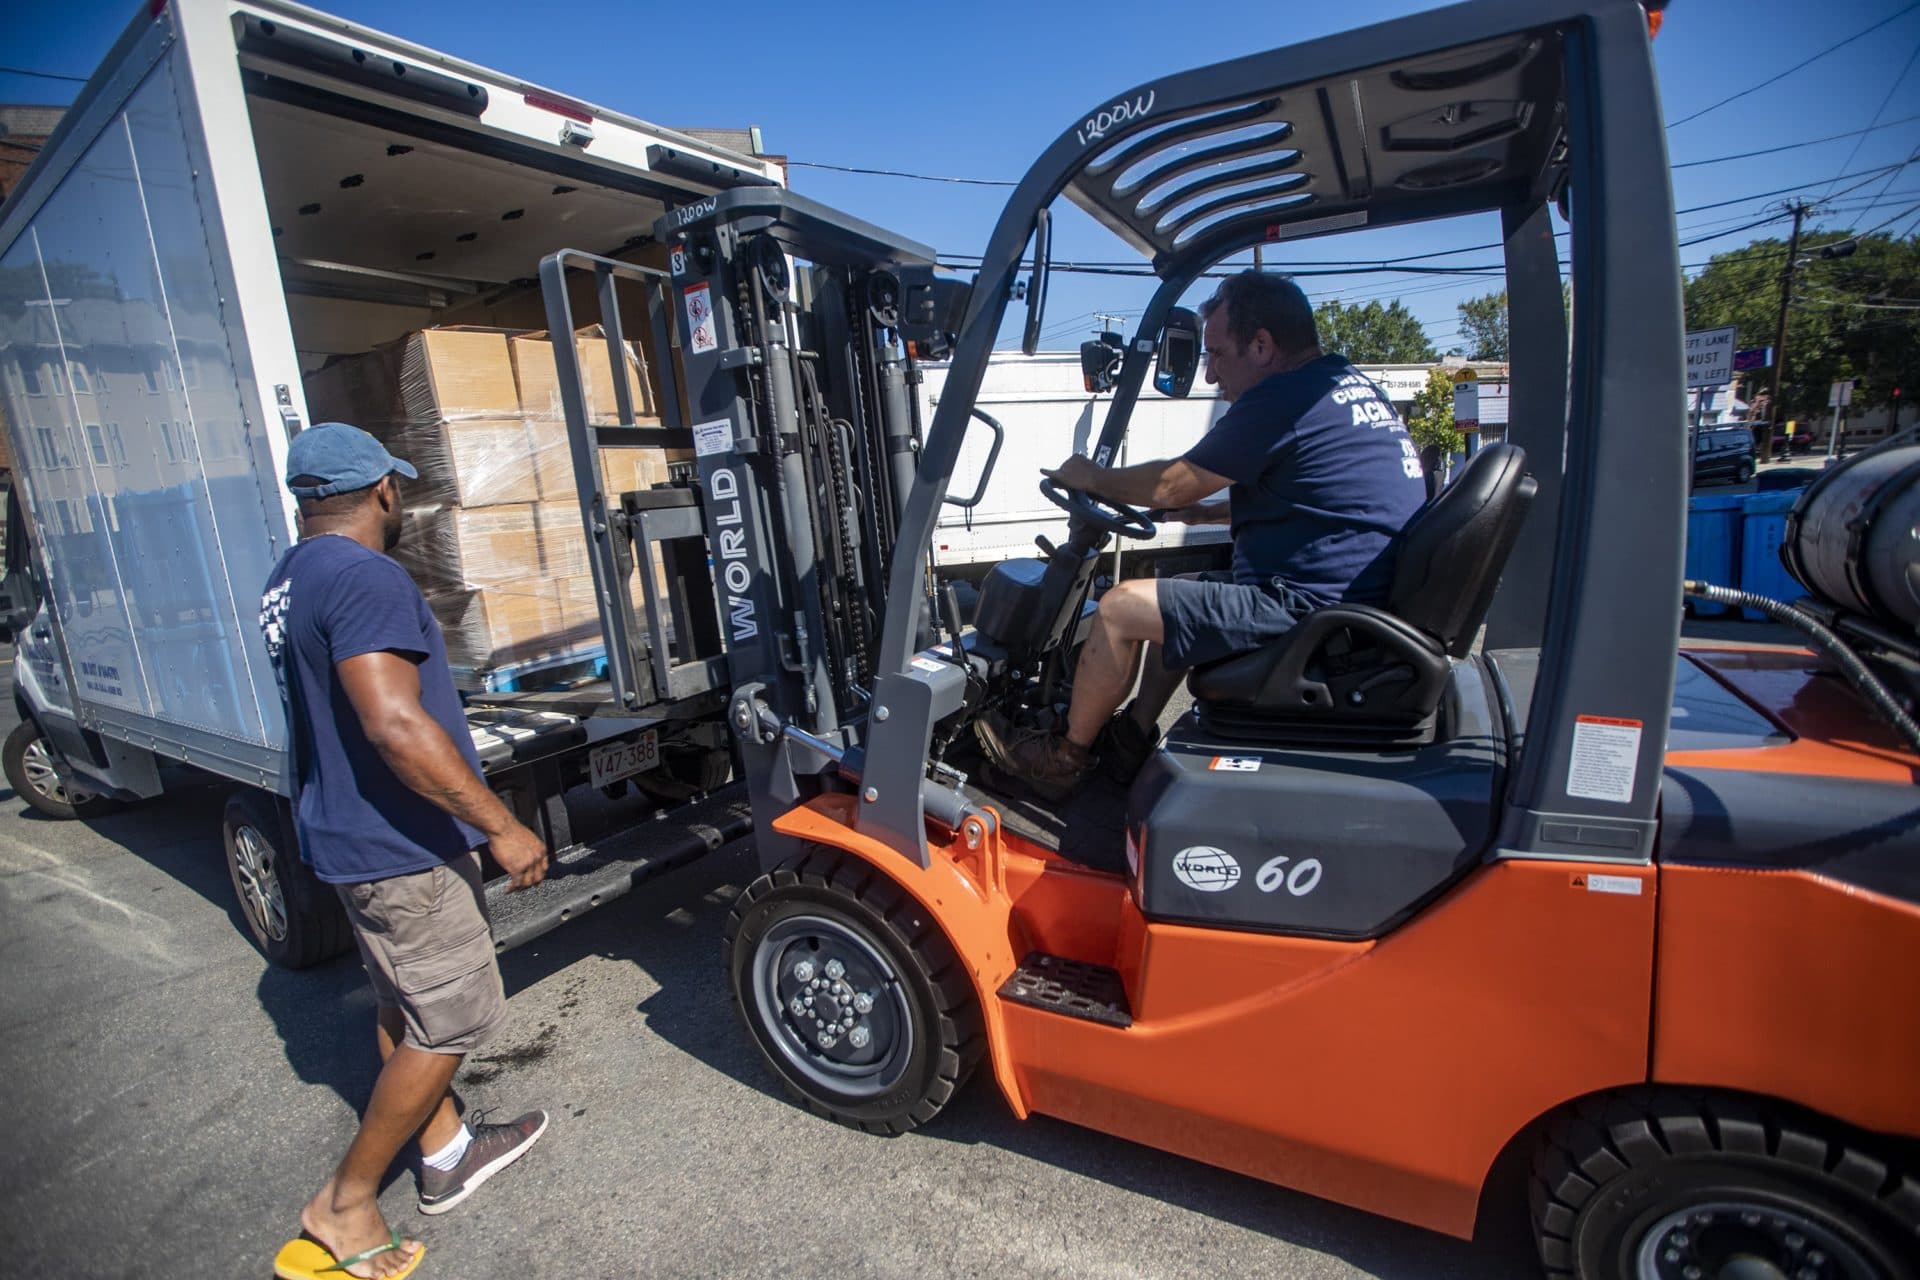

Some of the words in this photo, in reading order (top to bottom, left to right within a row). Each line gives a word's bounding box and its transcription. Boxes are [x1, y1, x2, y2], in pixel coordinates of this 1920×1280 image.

[1077, 90, 1155, 145] 1200W
[677, 196, 717, 225] 1200W
[1684, 338, 1700, 350] EFT
[1704, 334, 1730, 347] LANE
[1687, 352, 1720, 366] MUST
[1705, 368, 1728, 380] LEFT
[711, 468, 759, 641] WORLD
[1176, 861, 1239, 877] WORLD
[1256, 855, 1323, 897] 60
